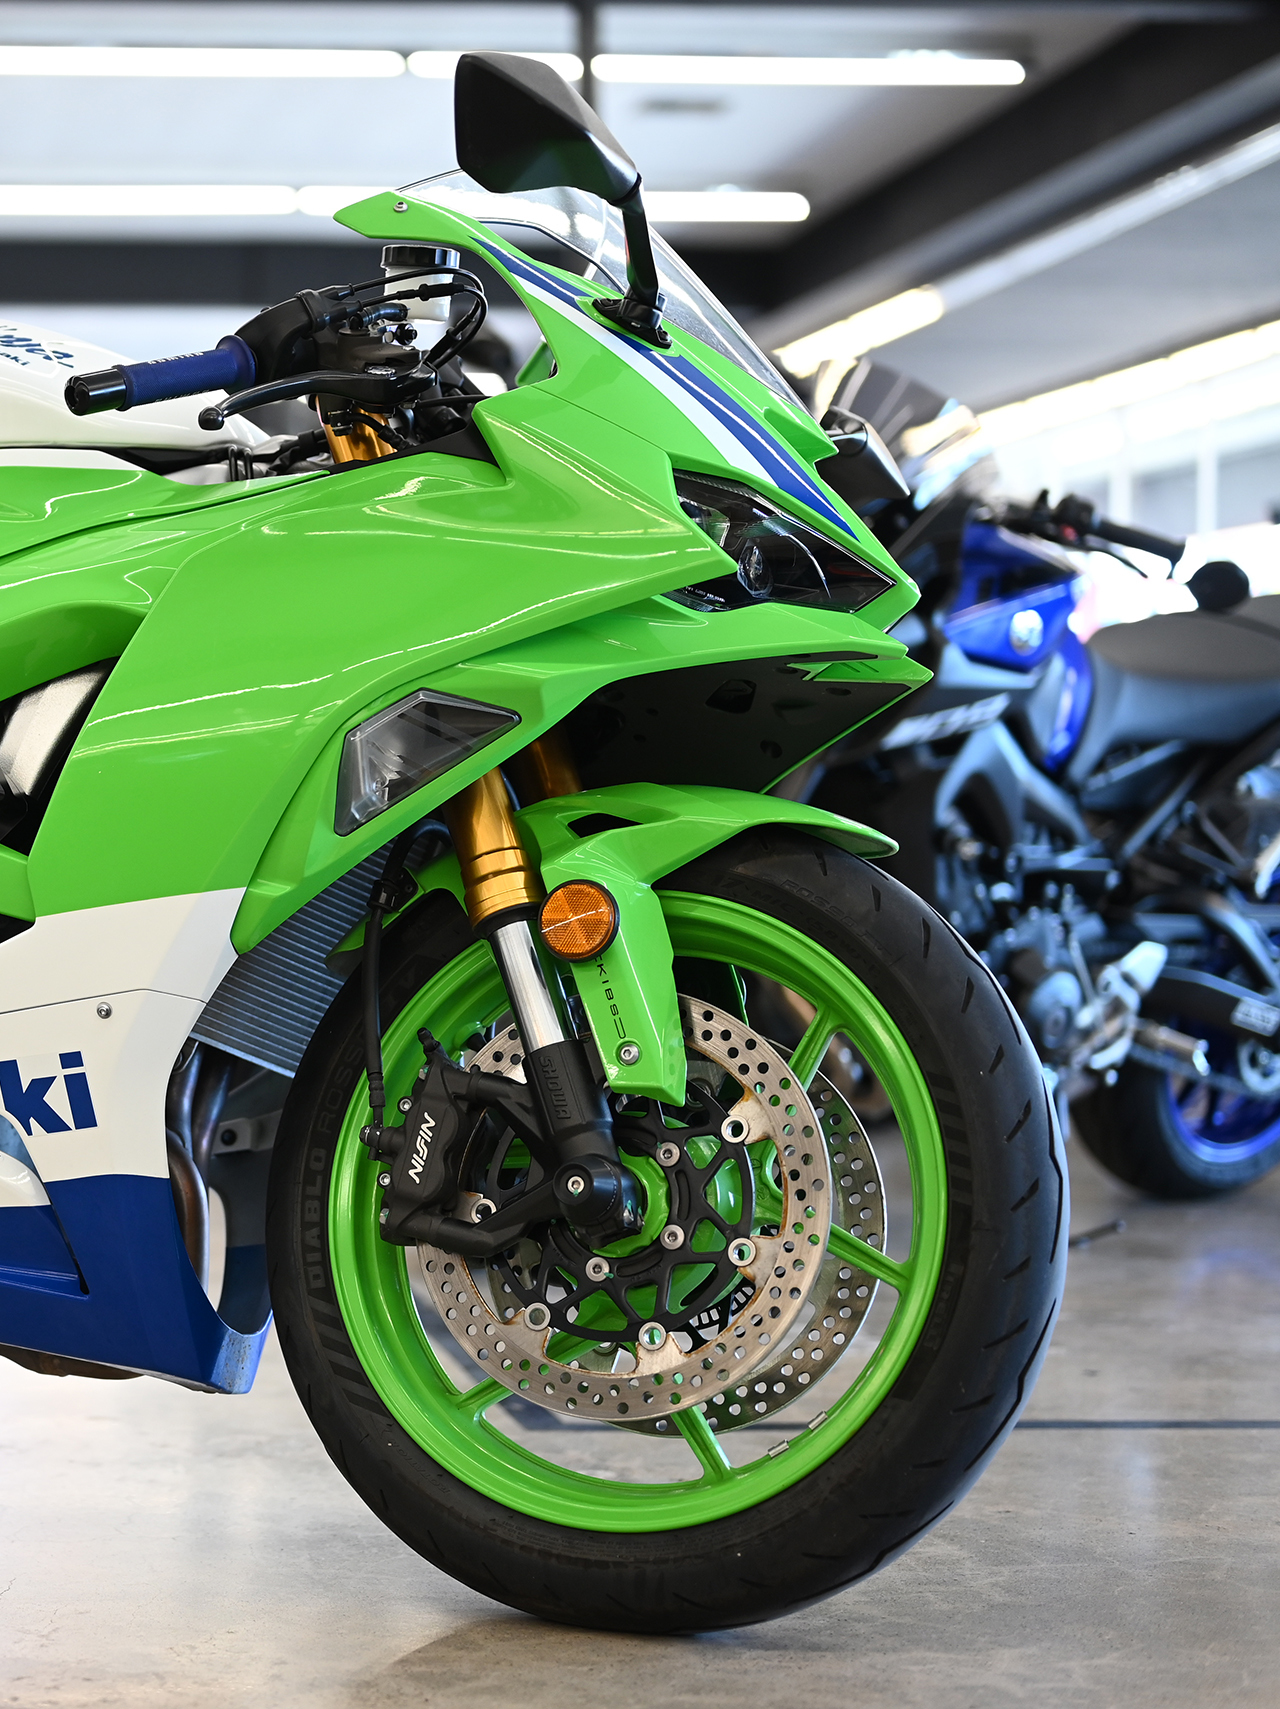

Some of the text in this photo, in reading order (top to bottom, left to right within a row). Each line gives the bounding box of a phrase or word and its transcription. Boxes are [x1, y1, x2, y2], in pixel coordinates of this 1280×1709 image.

[596, 963, 619, 1017] KIBS
[538, 1055, 571, 1121] SHOWA
[408, 1111, 436, 1185] NISSIN
[303, 1146, 328, 1290] DIABLO
